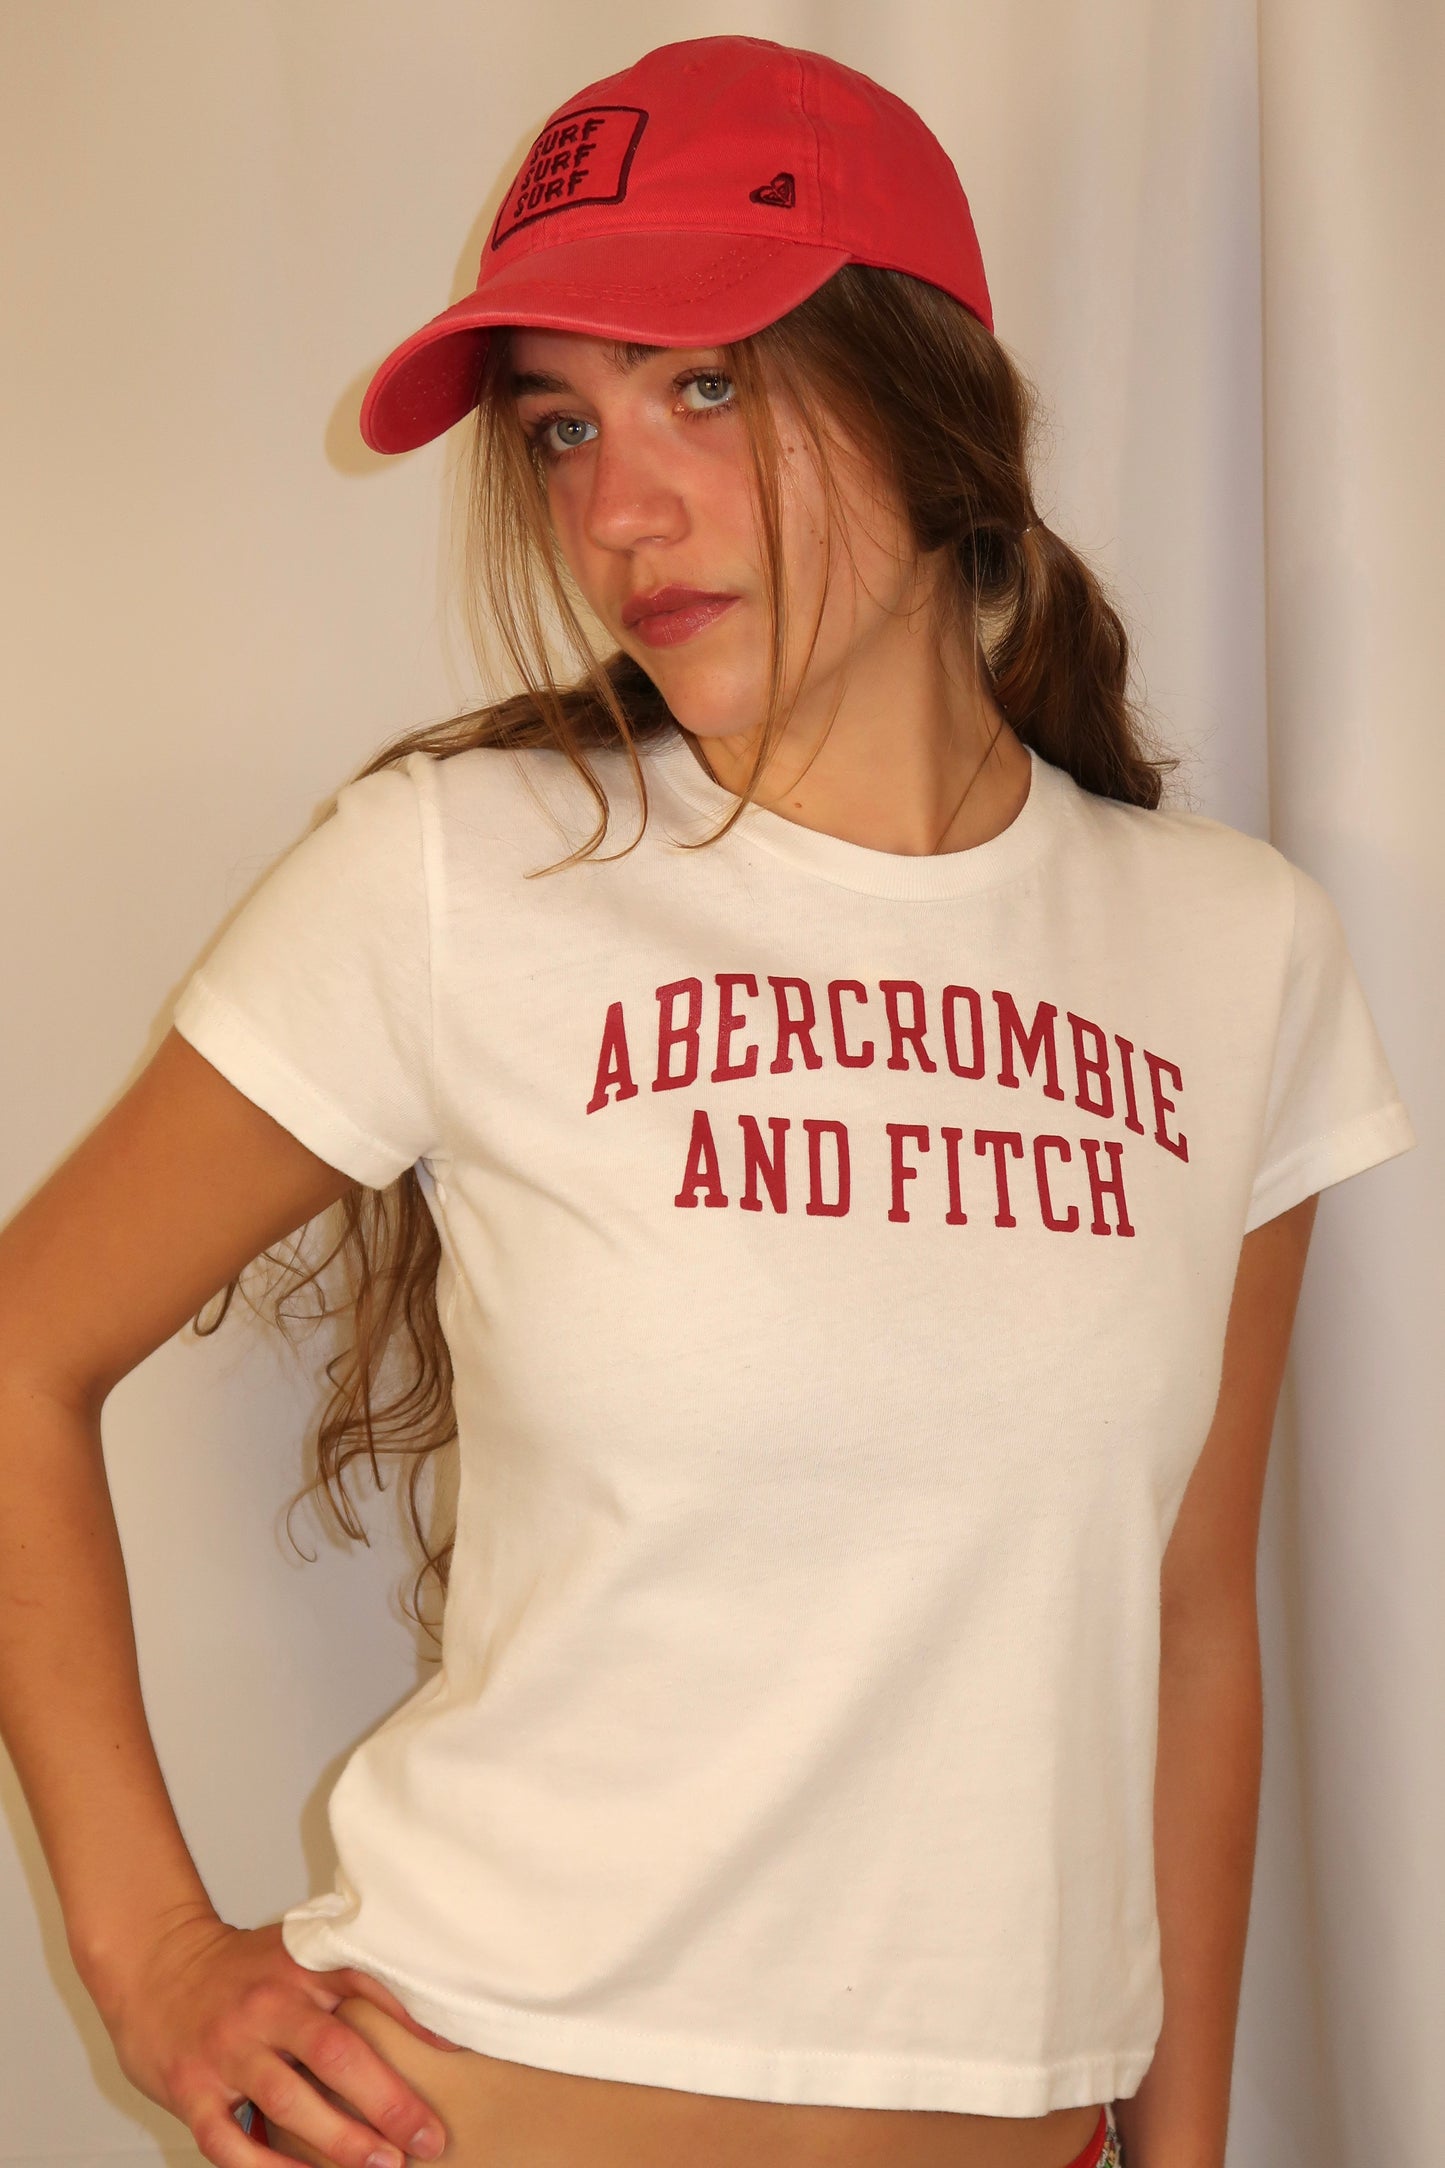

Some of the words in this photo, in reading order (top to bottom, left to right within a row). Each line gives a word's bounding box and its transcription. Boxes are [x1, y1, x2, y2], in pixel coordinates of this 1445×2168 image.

[530, 118, 606, 166] SURF
[520, 144, 597, 191] SURF
[513, 170, 590, 218] SURF
[587, 973, 1189, 1163] ABERCROMBIE
[675, 1110, 850, 1218] AND
[886, 1122, 1136, 1238] FITCH
